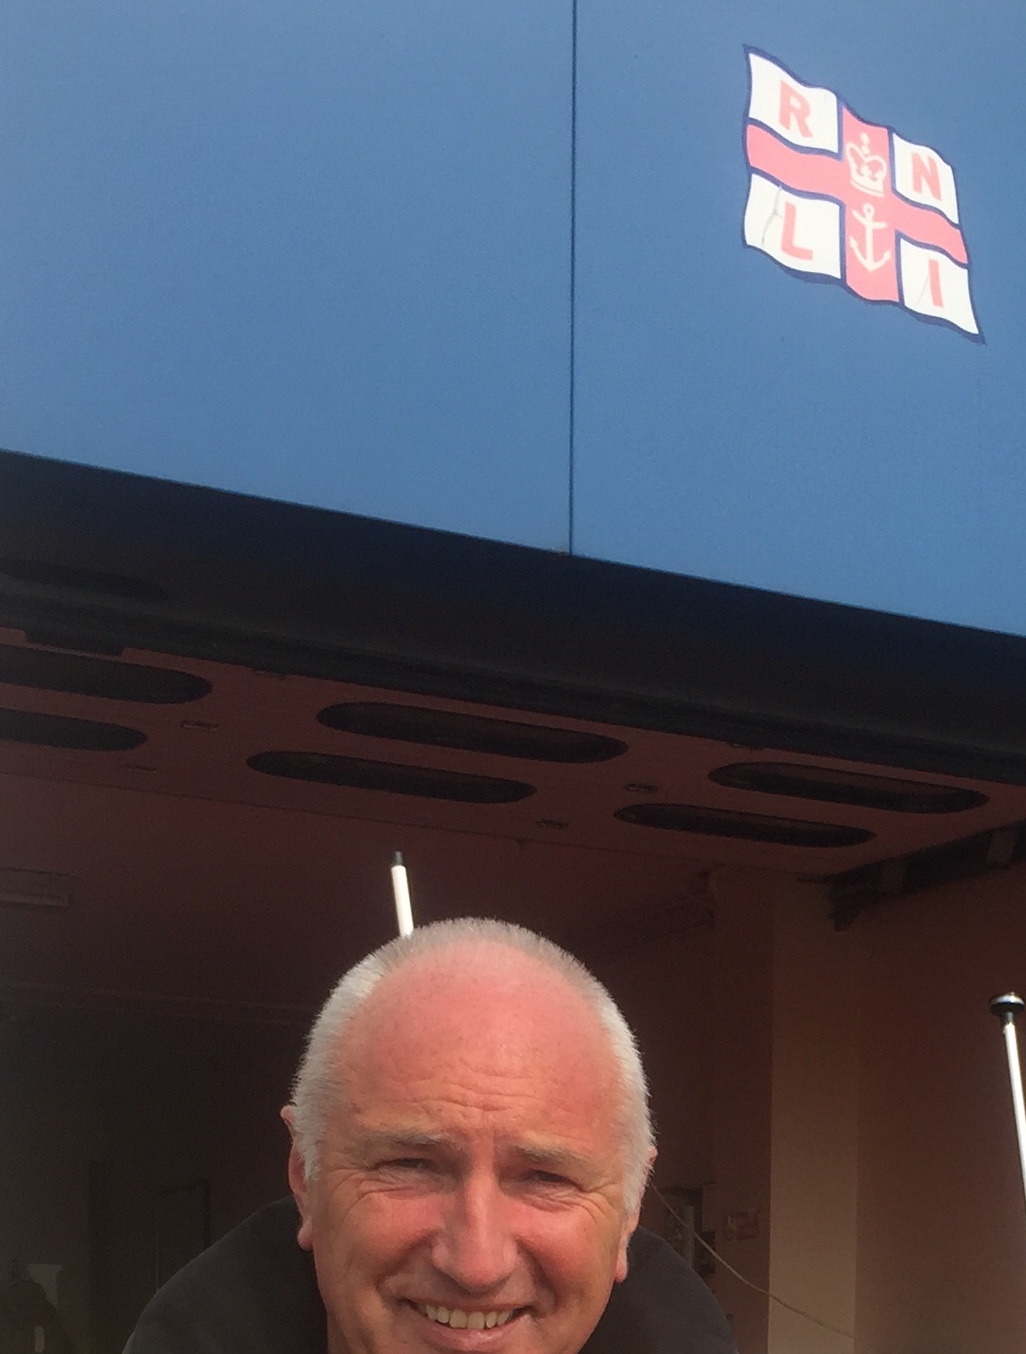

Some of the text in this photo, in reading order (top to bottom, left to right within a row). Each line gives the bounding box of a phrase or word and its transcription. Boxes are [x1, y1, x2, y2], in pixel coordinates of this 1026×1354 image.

[778, 79, 942, 201] R N
[781, 201, 944, 308] L I
